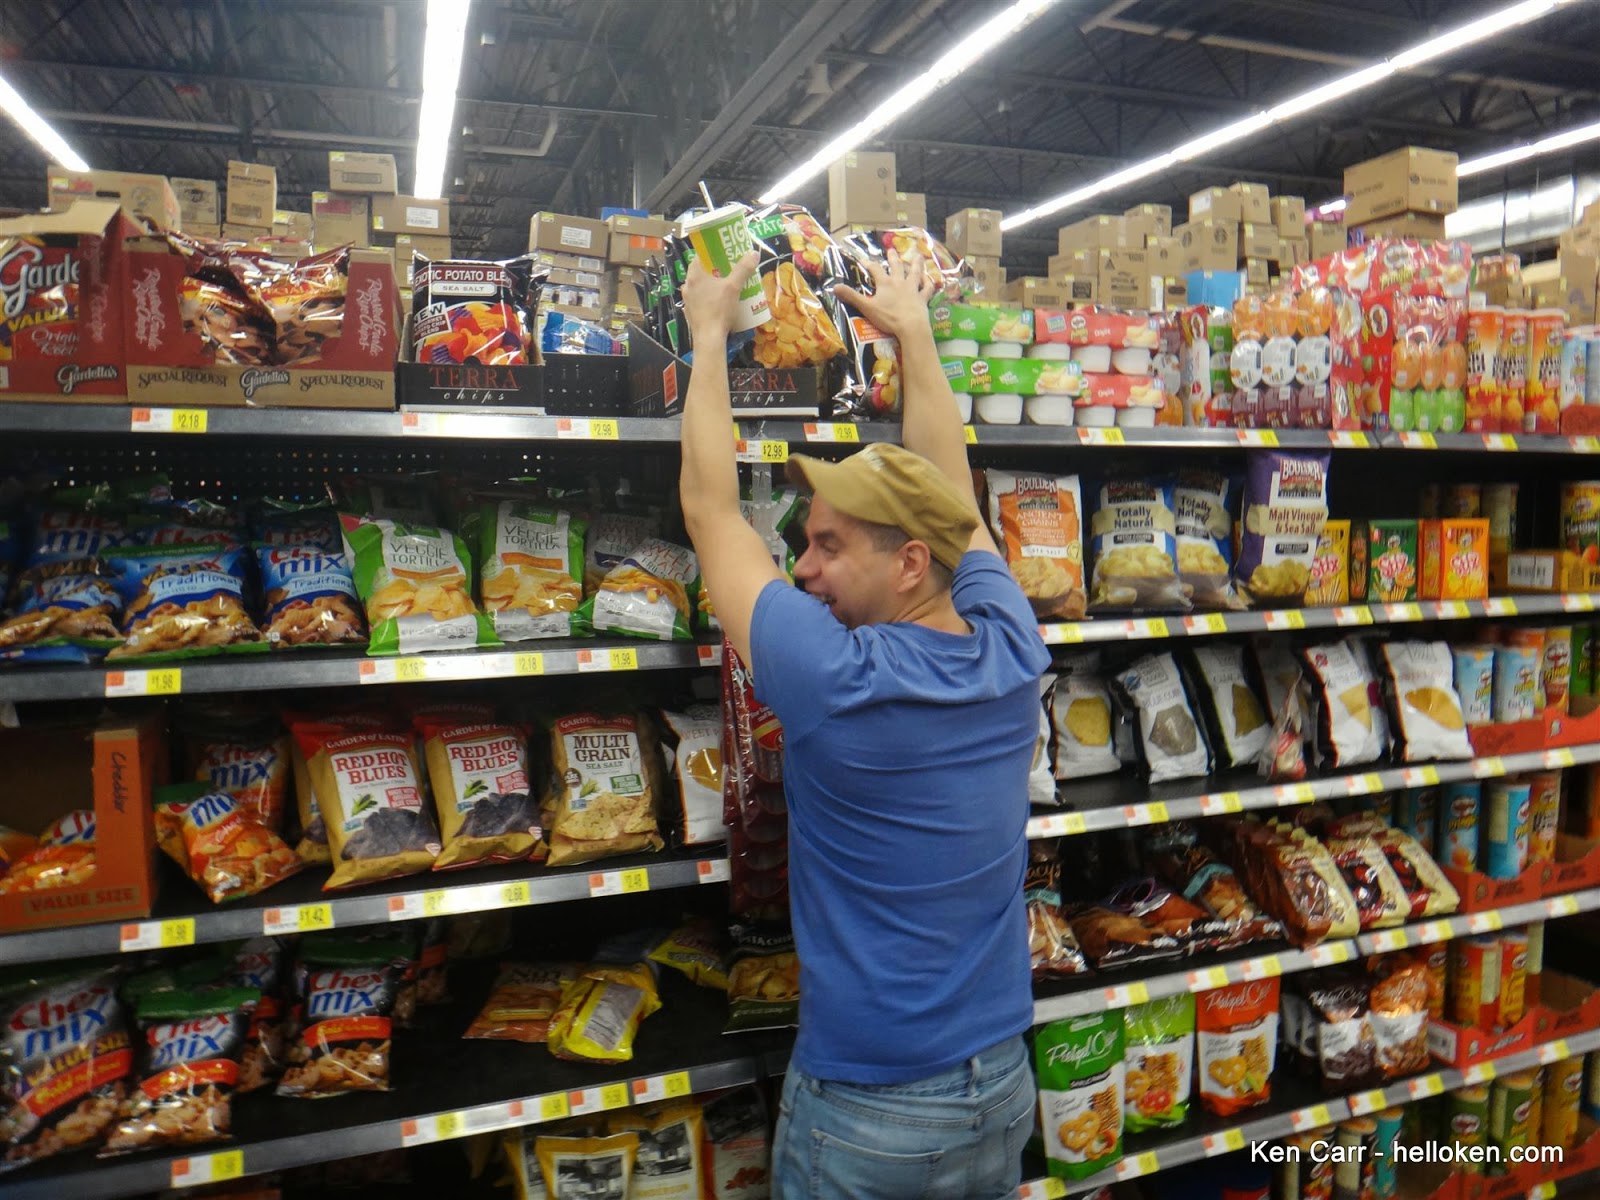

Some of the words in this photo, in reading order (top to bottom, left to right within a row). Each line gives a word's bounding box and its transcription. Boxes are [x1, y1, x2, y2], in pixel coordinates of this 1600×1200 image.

[445, 270, 484, 281] POTATO
[300, 374, 340, 392] SPECIAL
[339, 374, 385, 390] REQUEST
[429, 367, 519, 389] TERRA
[443, 387, 505, 404] chips
[732, 391, 785, 406] chips
[763, 445, 783, 458] $2.98
[1017, 478, 1057, 495] BOULDER
[1116, 507, 1151, 521] Totally
[1269, 508, 1289, 521] Malt
[1291, 508, 1325, 522] Vinegar
[1114, 518, 1153, 529] Natural
[1285, 524, 1298, 534] Sea
[1301, 524, 1316, 534] Salt
[450, 745, 486, 760] RED
[488, 739, 521, 755] HOT
[573, 734, 628, 749] MULTI
[334, 754, 375, 772] RED
[375, 751, 408, 766] HOT
[461, 751, 518, 772] BLUES
[575, 747, 630, 762] GRAIN
[210, 755, 277, 788] mix
[603, 761, 624, 769] SALT
[347, 765, 407, 784] BLUES
[310, 968, 387, 992] Chex
[309, 985, 382, 1015] mix
[25, 995, 110, 1057] mix
